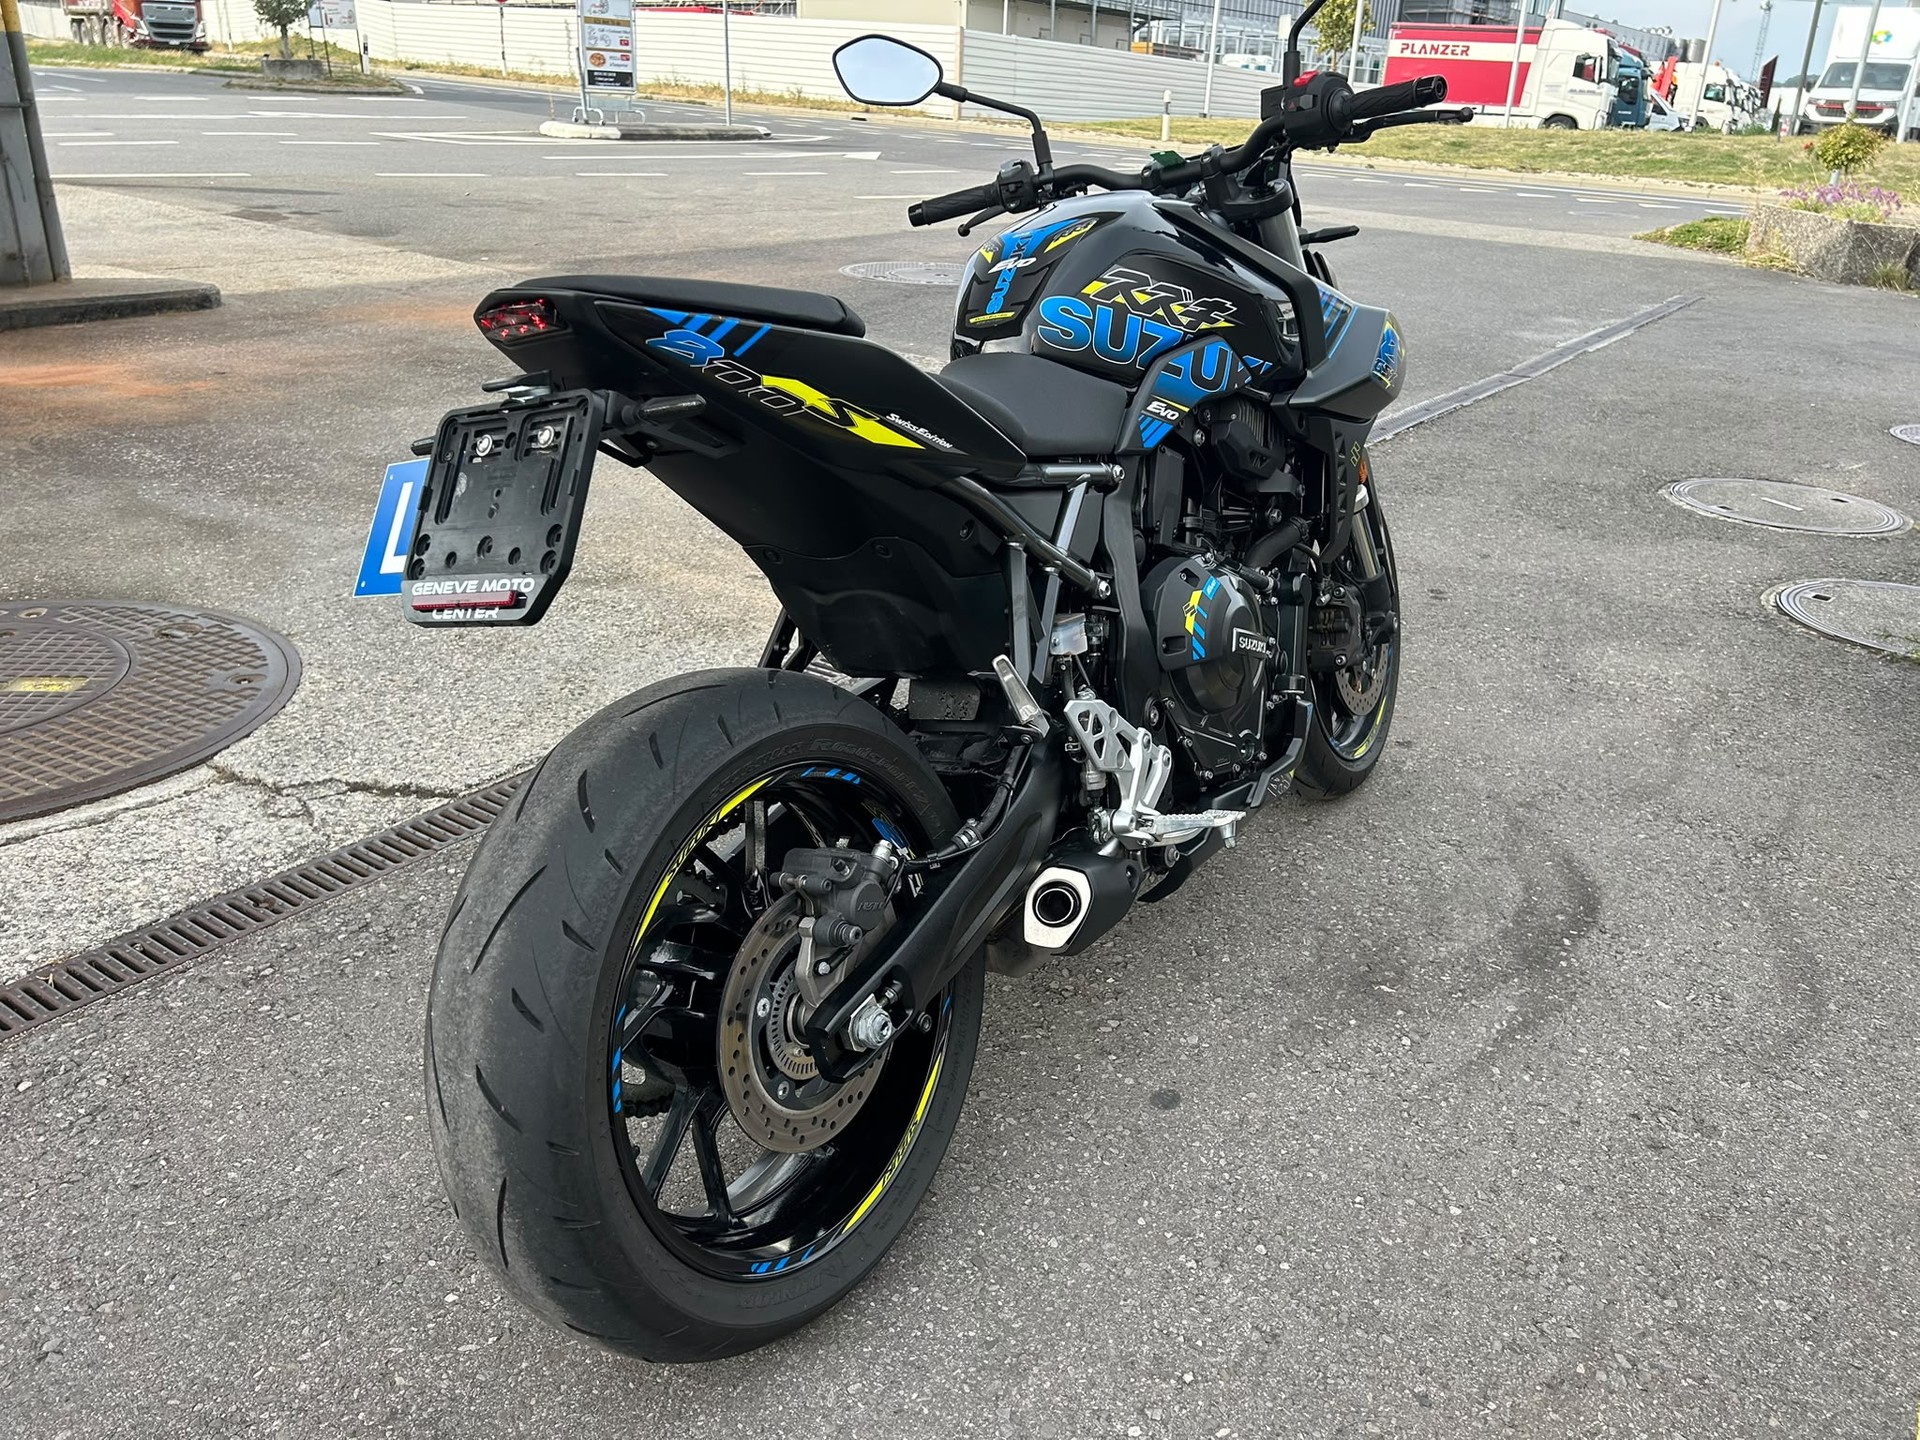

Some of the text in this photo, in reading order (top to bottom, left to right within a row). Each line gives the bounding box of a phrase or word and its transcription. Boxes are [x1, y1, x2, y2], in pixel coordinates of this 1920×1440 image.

[1400, 43, 1470, 57] PLANZER
[379, 481, 413, 575] L
[411, 577, 535, 596] GENEVE MOTO
[432, 607, 499, 620] CENTER
[1239, 636, 1266, 654] SUZUKI
